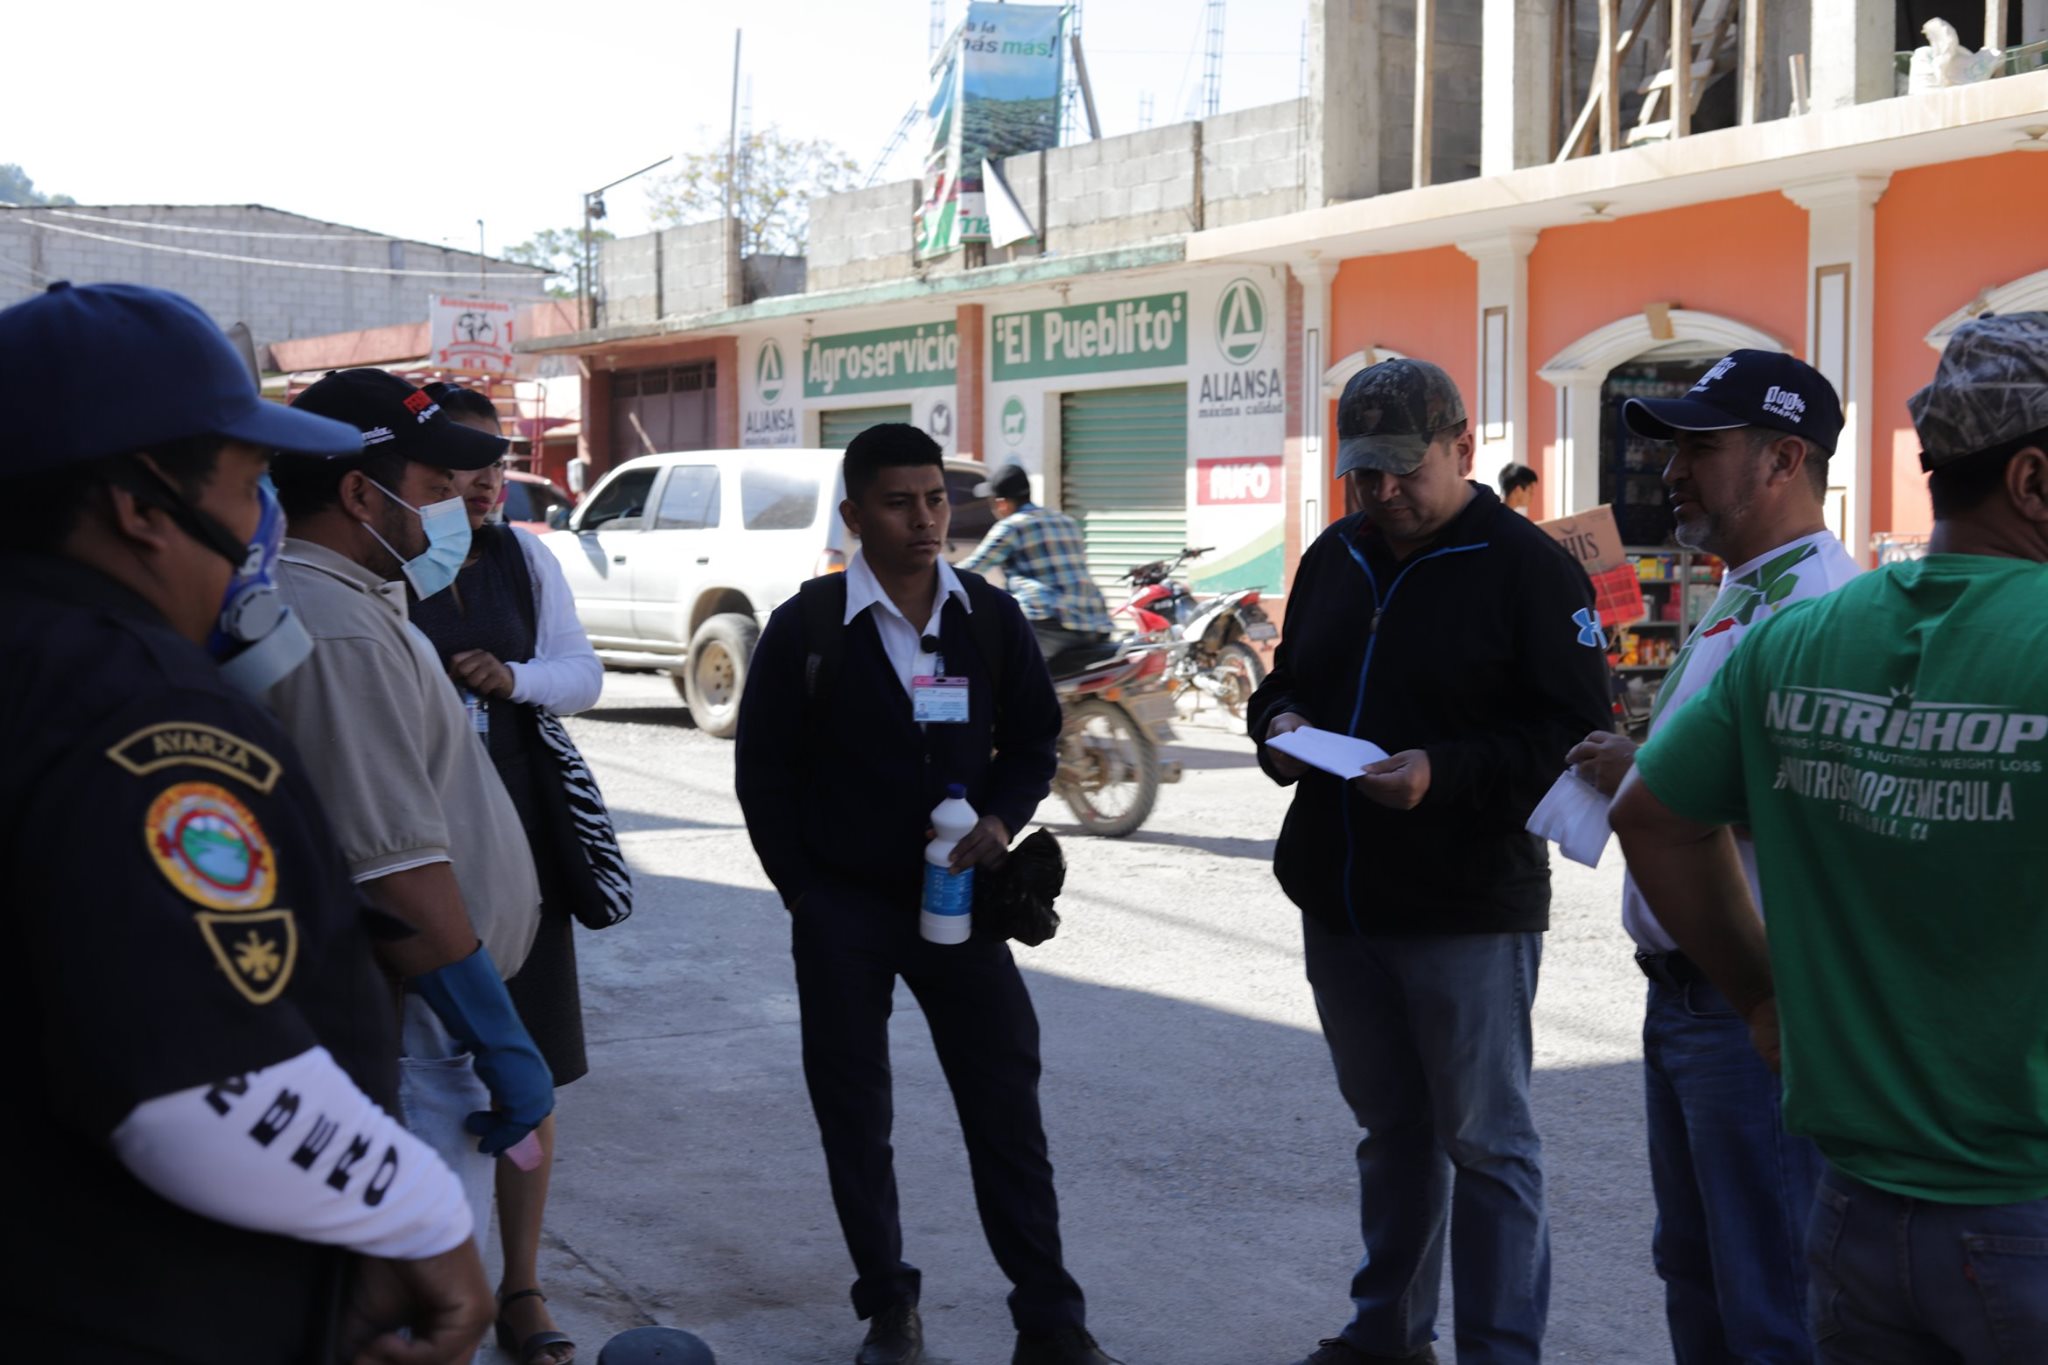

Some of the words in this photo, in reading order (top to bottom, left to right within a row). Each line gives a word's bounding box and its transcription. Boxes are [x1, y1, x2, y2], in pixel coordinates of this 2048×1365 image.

[808, 328, 958, 394] Agroservicio
[1199, 368, 1283, 403] ALIANSA
[744, 408, 796, 433] ALIANSA
[1765, 690, 2048, 754] NUTRISHOP
[153, 731, 249, 770] AYARZA
[1940, 757, 1995, 771] WEIGHT
[2001, 759, 2043, 773] LOSS
